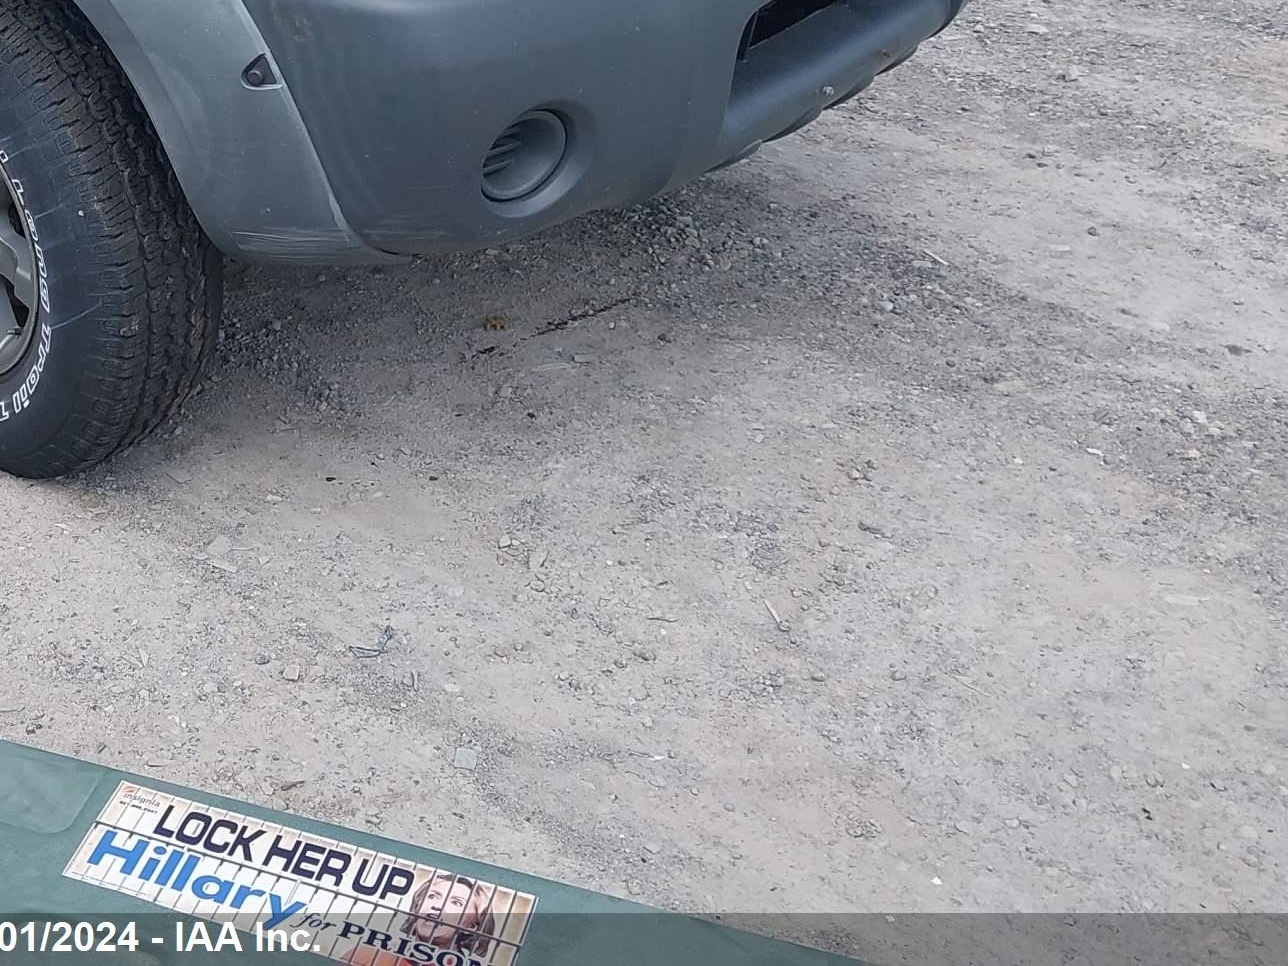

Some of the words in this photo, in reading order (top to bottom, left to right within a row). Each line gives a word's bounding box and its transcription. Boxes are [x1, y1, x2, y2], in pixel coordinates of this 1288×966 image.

[11, 322, 52, 414] Trail
[122, 792, 161, 807] insignia
[87, 829, 308, 931] Hillary
[289, 912, 337, 931] for
[152, 804, 267, 863] LOCK
[262, 835, 352, 886] HER
[352, 858, 415, 899] UP
